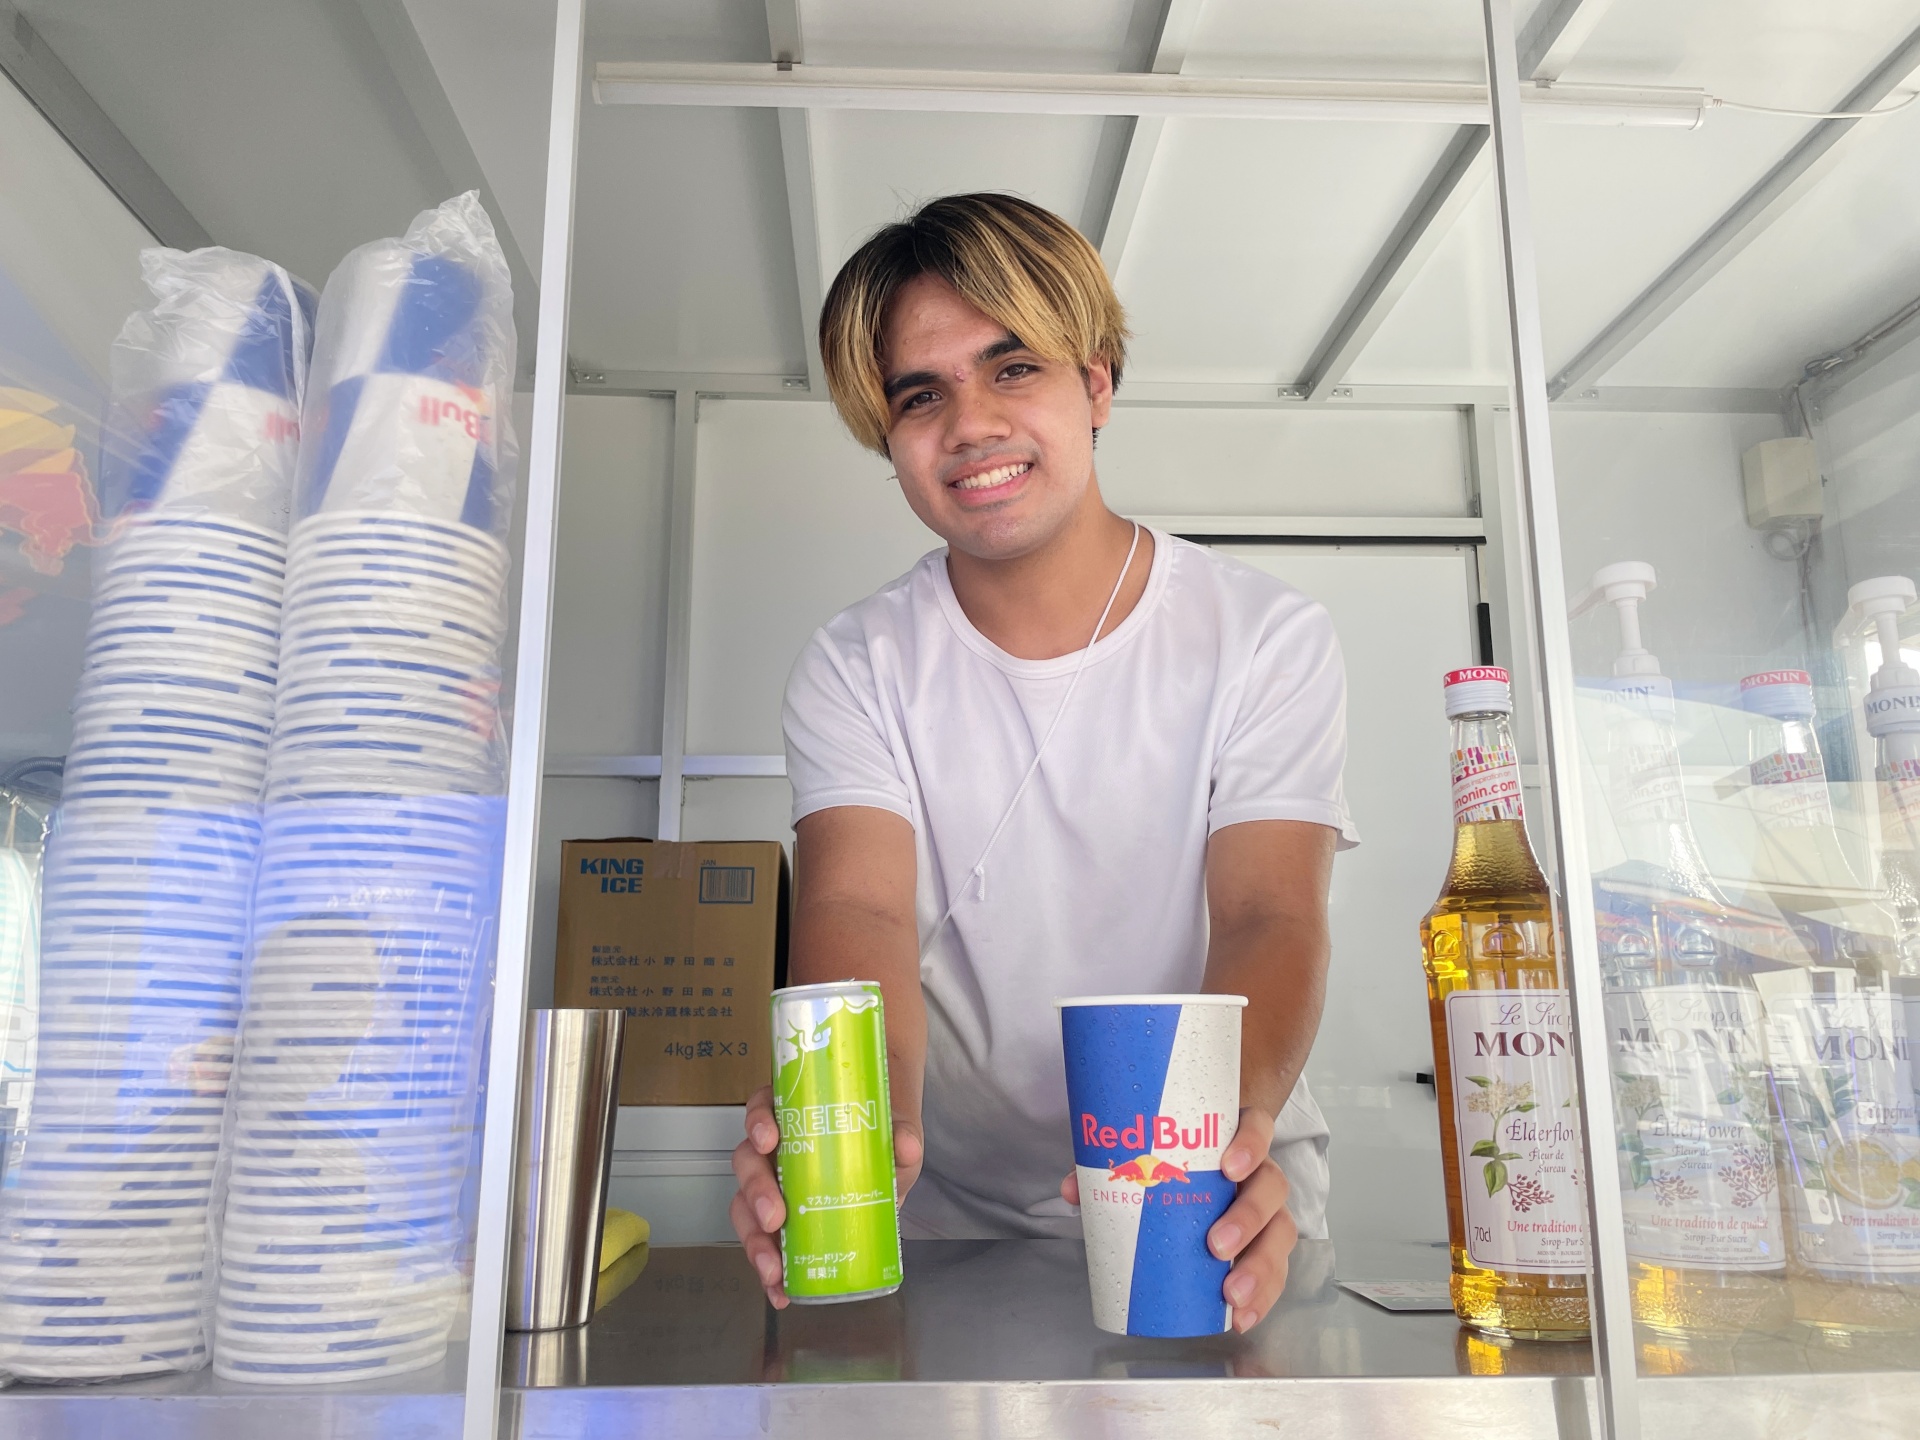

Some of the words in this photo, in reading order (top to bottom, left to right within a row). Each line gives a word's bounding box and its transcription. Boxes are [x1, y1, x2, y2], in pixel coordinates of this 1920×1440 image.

[1459, 669, 1508, 680] MONIN
[1745, 671, 1800, 686] MONIN
[1602, 685, 1650, 705] ONIN
[1455, 780, 1517, 808] monin.com
[580, 858, 645, 875] KING
[600, 877, 643, 893] ICE
[626, 1006, 734, 1018] 製氷冷蔵株式会社
[1473, 1031, 1575, 1057] MON
[1618, 1027, 1758, 1054] MONIN
[1081, 1113, 1145, 1150] Red
[1152, 1113, 1219, 1150] Bull
[1528, 1147, 1553, 1162] Fleur
[1555, 1149, 1564, 1160] de
[1534, 1161, 1566, 1176] Sureau
[806, 1189, 884, 1206] マスカットフレーバー
[1093, 1188, 1154, 1206] ENERGY
[1162, 1191, 1212, 1206] DRINK
[1507, 1220, 1530, 1233] Une
[1532, 1219, 1577, 1233] tradition
[1651, 1214, 1672, 1227] Une
[1675, 1213, 1724, 1230] tradition
[1727, 1216, 1739, 1230] de
[1474, 1226, 1492, 1243] 70cl
[1541, 1237, 1578, 1249] Sirop-Pur
[793, 1251, 857, 1265] エナジードリンク
[807, 1266, 838, 1280] 無果汁
